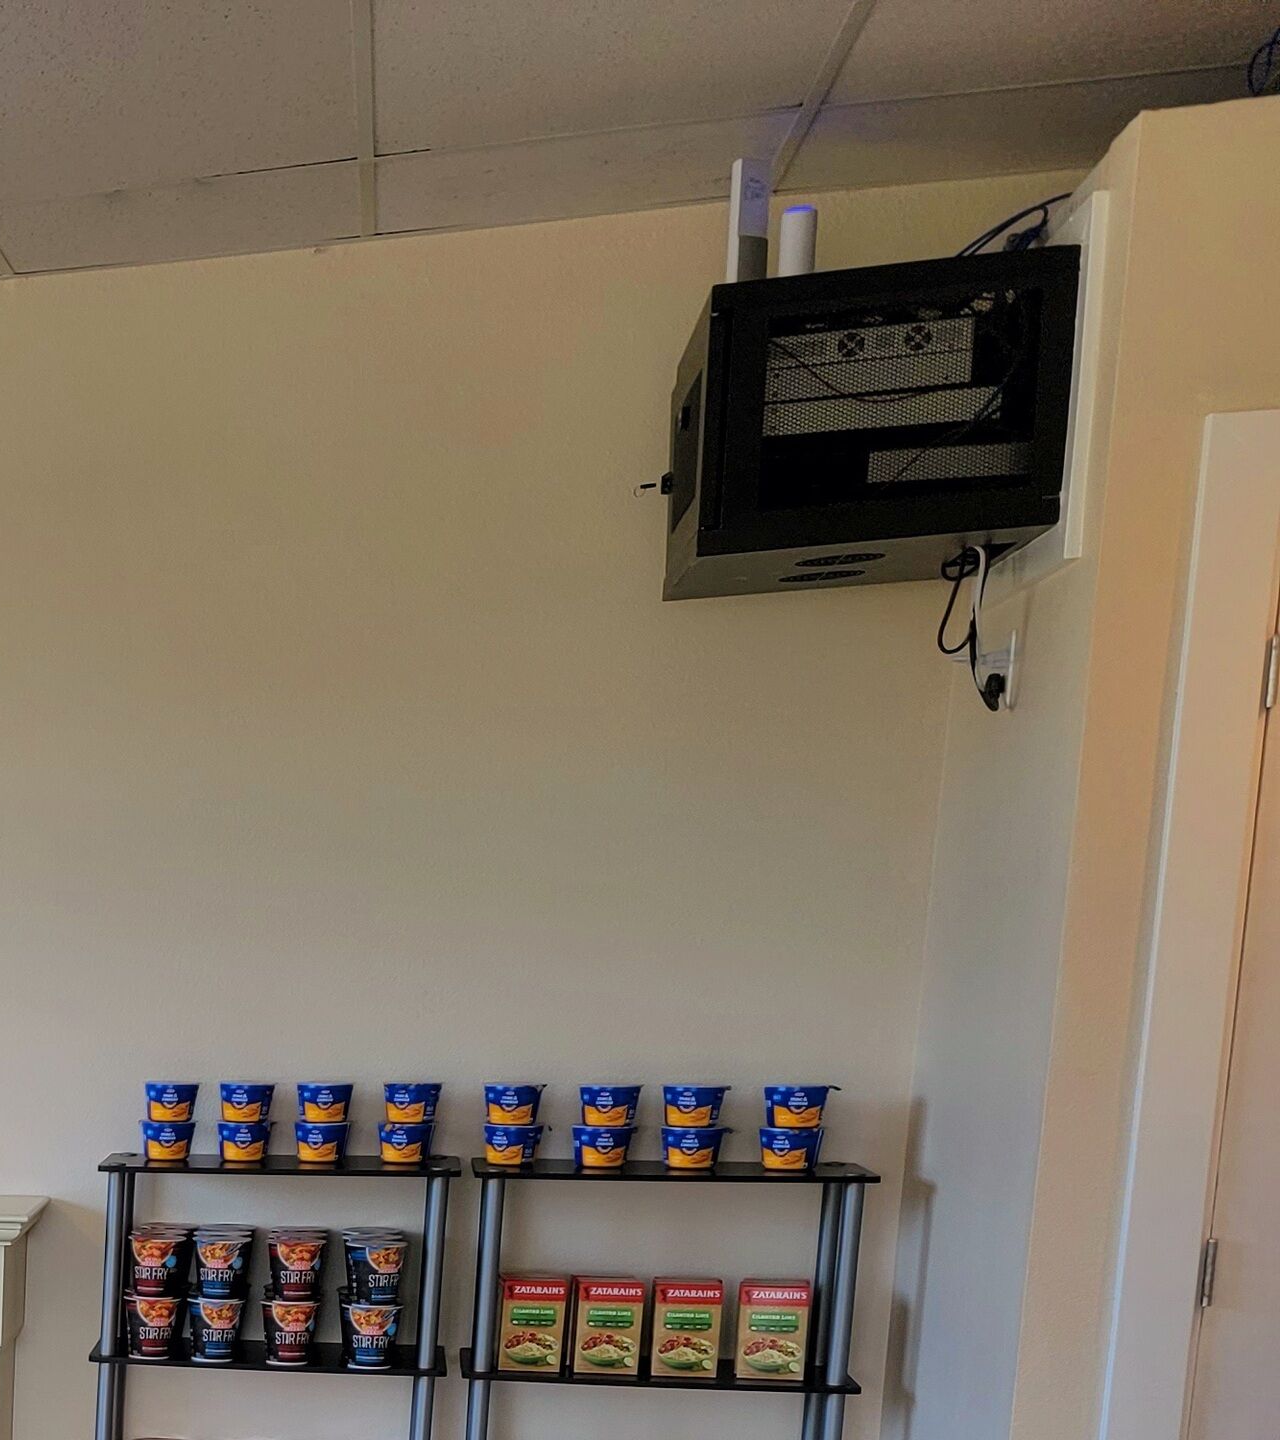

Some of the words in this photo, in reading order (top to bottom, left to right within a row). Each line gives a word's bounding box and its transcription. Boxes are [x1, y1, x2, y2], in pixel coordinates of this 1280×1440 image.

[134, 1266, 151, 1280] STIR
[152, 1268, 168, 1281] FRY
[200, 1268, 217, 1281] STIR
[218, 1269, 235, 1283] FRY
[281, 1271, 298, 1284] STIR
[299, 1272, 315, 1284] FRY
[368, 1274, 387, 1287] STIR
[514, 1285, 565, 1295] ZATARAIN'S
[590, 1287, 642, 1297] ZATARAIN'S
[667, 1289, 721, 1299] ZATARAIN'S
[752, 1290, 808, 1300] ZATARAIN'S
[139, 1326, 156, 1340] STIR
[203, 1328, 220, 1342] STIR
[275, 1331, 294, 1345] STIR
[295, 1333, 309, 1345] FRY
[352, 1335, 371, 1348] STIR
[372, 1336, 390, 1349] FRY
